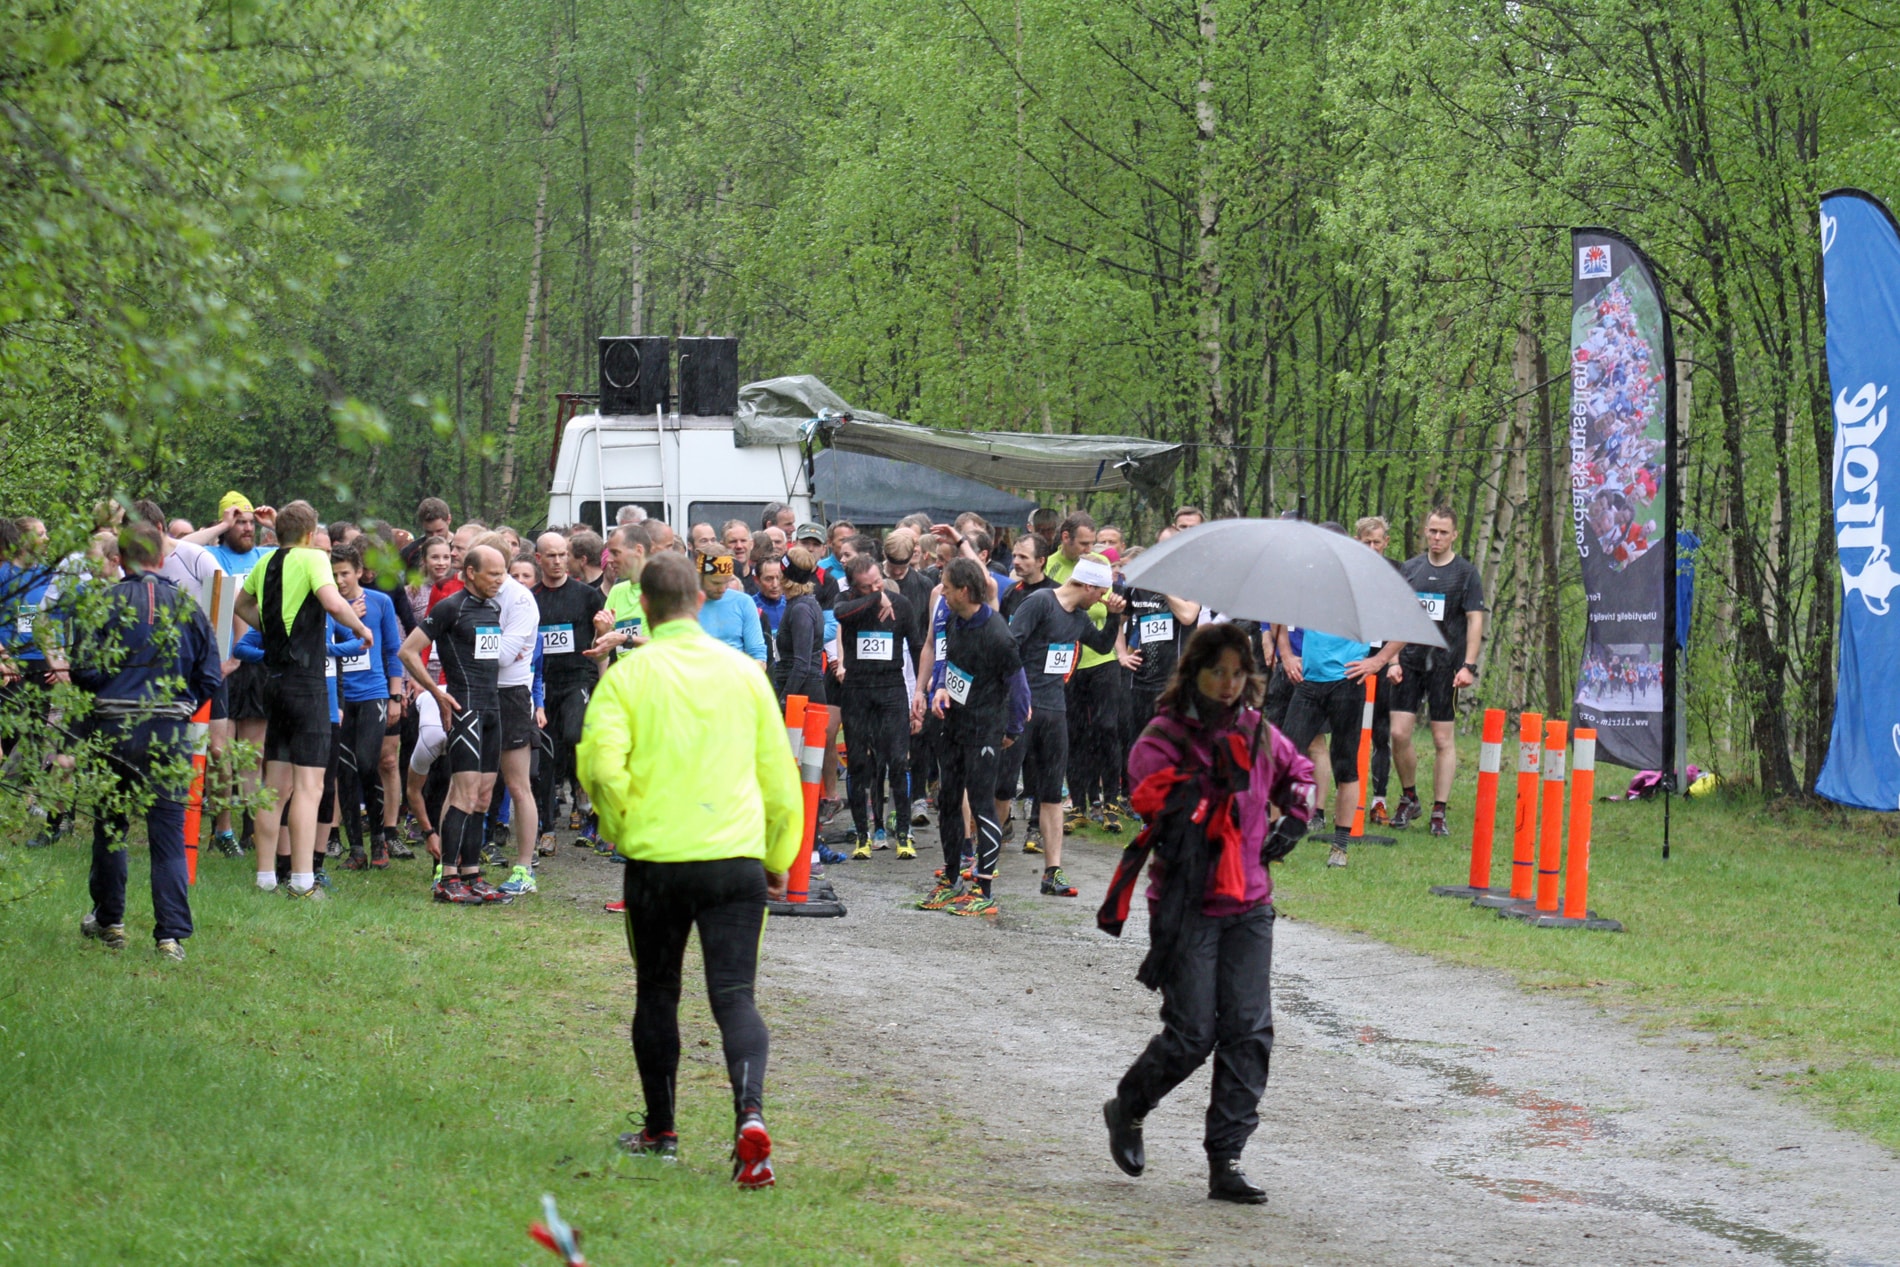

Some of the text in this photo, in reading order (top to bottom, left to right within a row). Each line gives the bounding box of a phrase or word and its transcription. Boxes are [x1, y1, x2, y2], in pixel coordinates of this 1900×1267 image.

[1145, 620, 1168, 635] 134
[480, 635, 499, 650] 200
[544, 632, 568, 646] 126
[862, 638, 886, 652] 231
[1054, 651, 1067, 666] 94
[946, 671, 966, 693] 269
